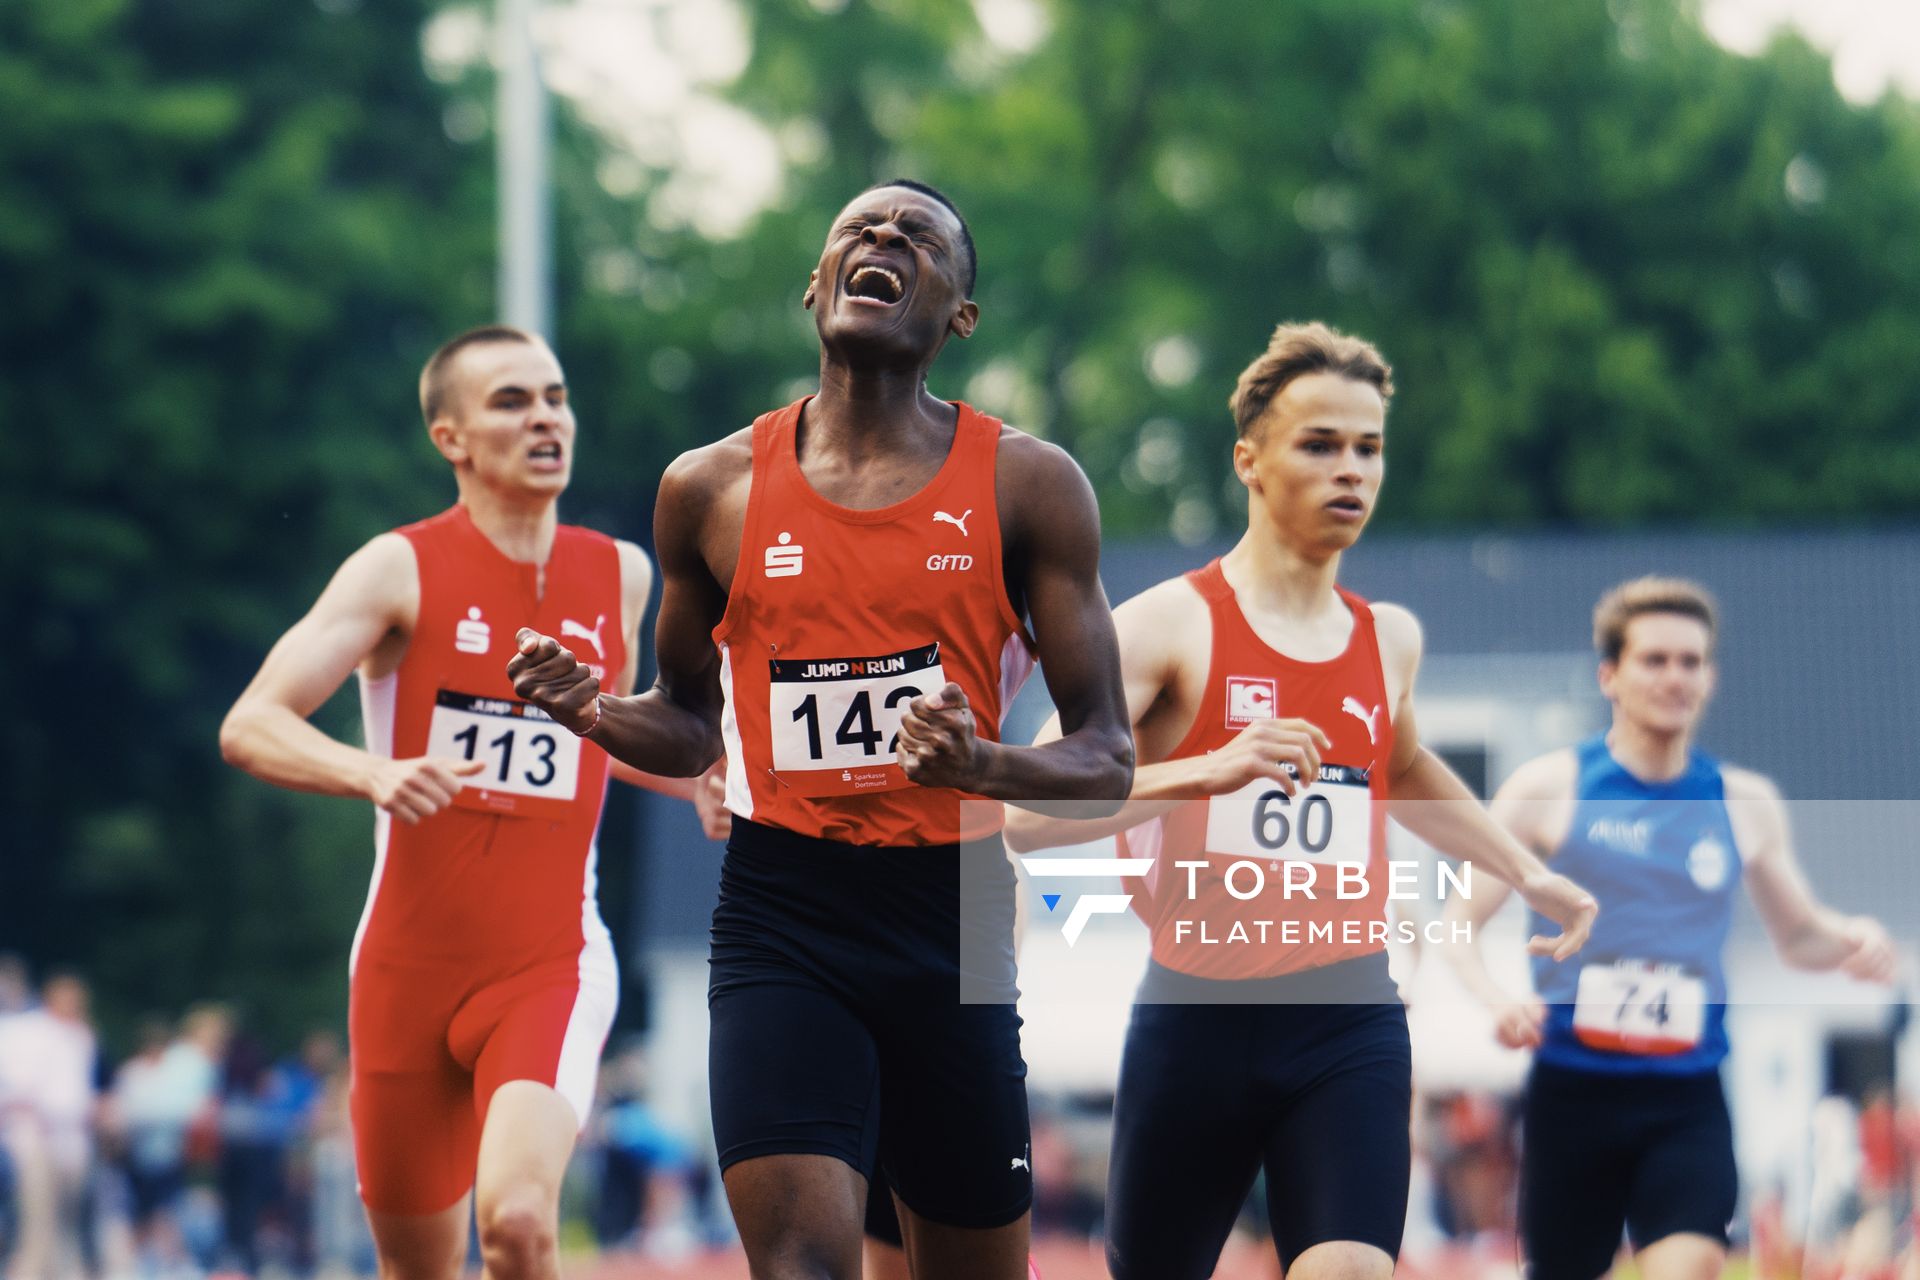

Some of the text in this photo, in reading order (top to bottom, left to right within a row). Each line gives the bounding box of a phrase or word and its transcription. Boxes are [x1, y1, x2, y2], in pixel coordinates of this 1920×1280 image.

[926, 554, 973, 571] GfTD
[801, 656, 906, 678] JUMP N RUN
[453, 724, 556, 787] 113
[854, 772, 886, 781] Sparkasse
[854, 780, 887, 789] Dortmund
[1252, 789, 1333, 854] 60
[1612, 981, 1671, 1026] 74
